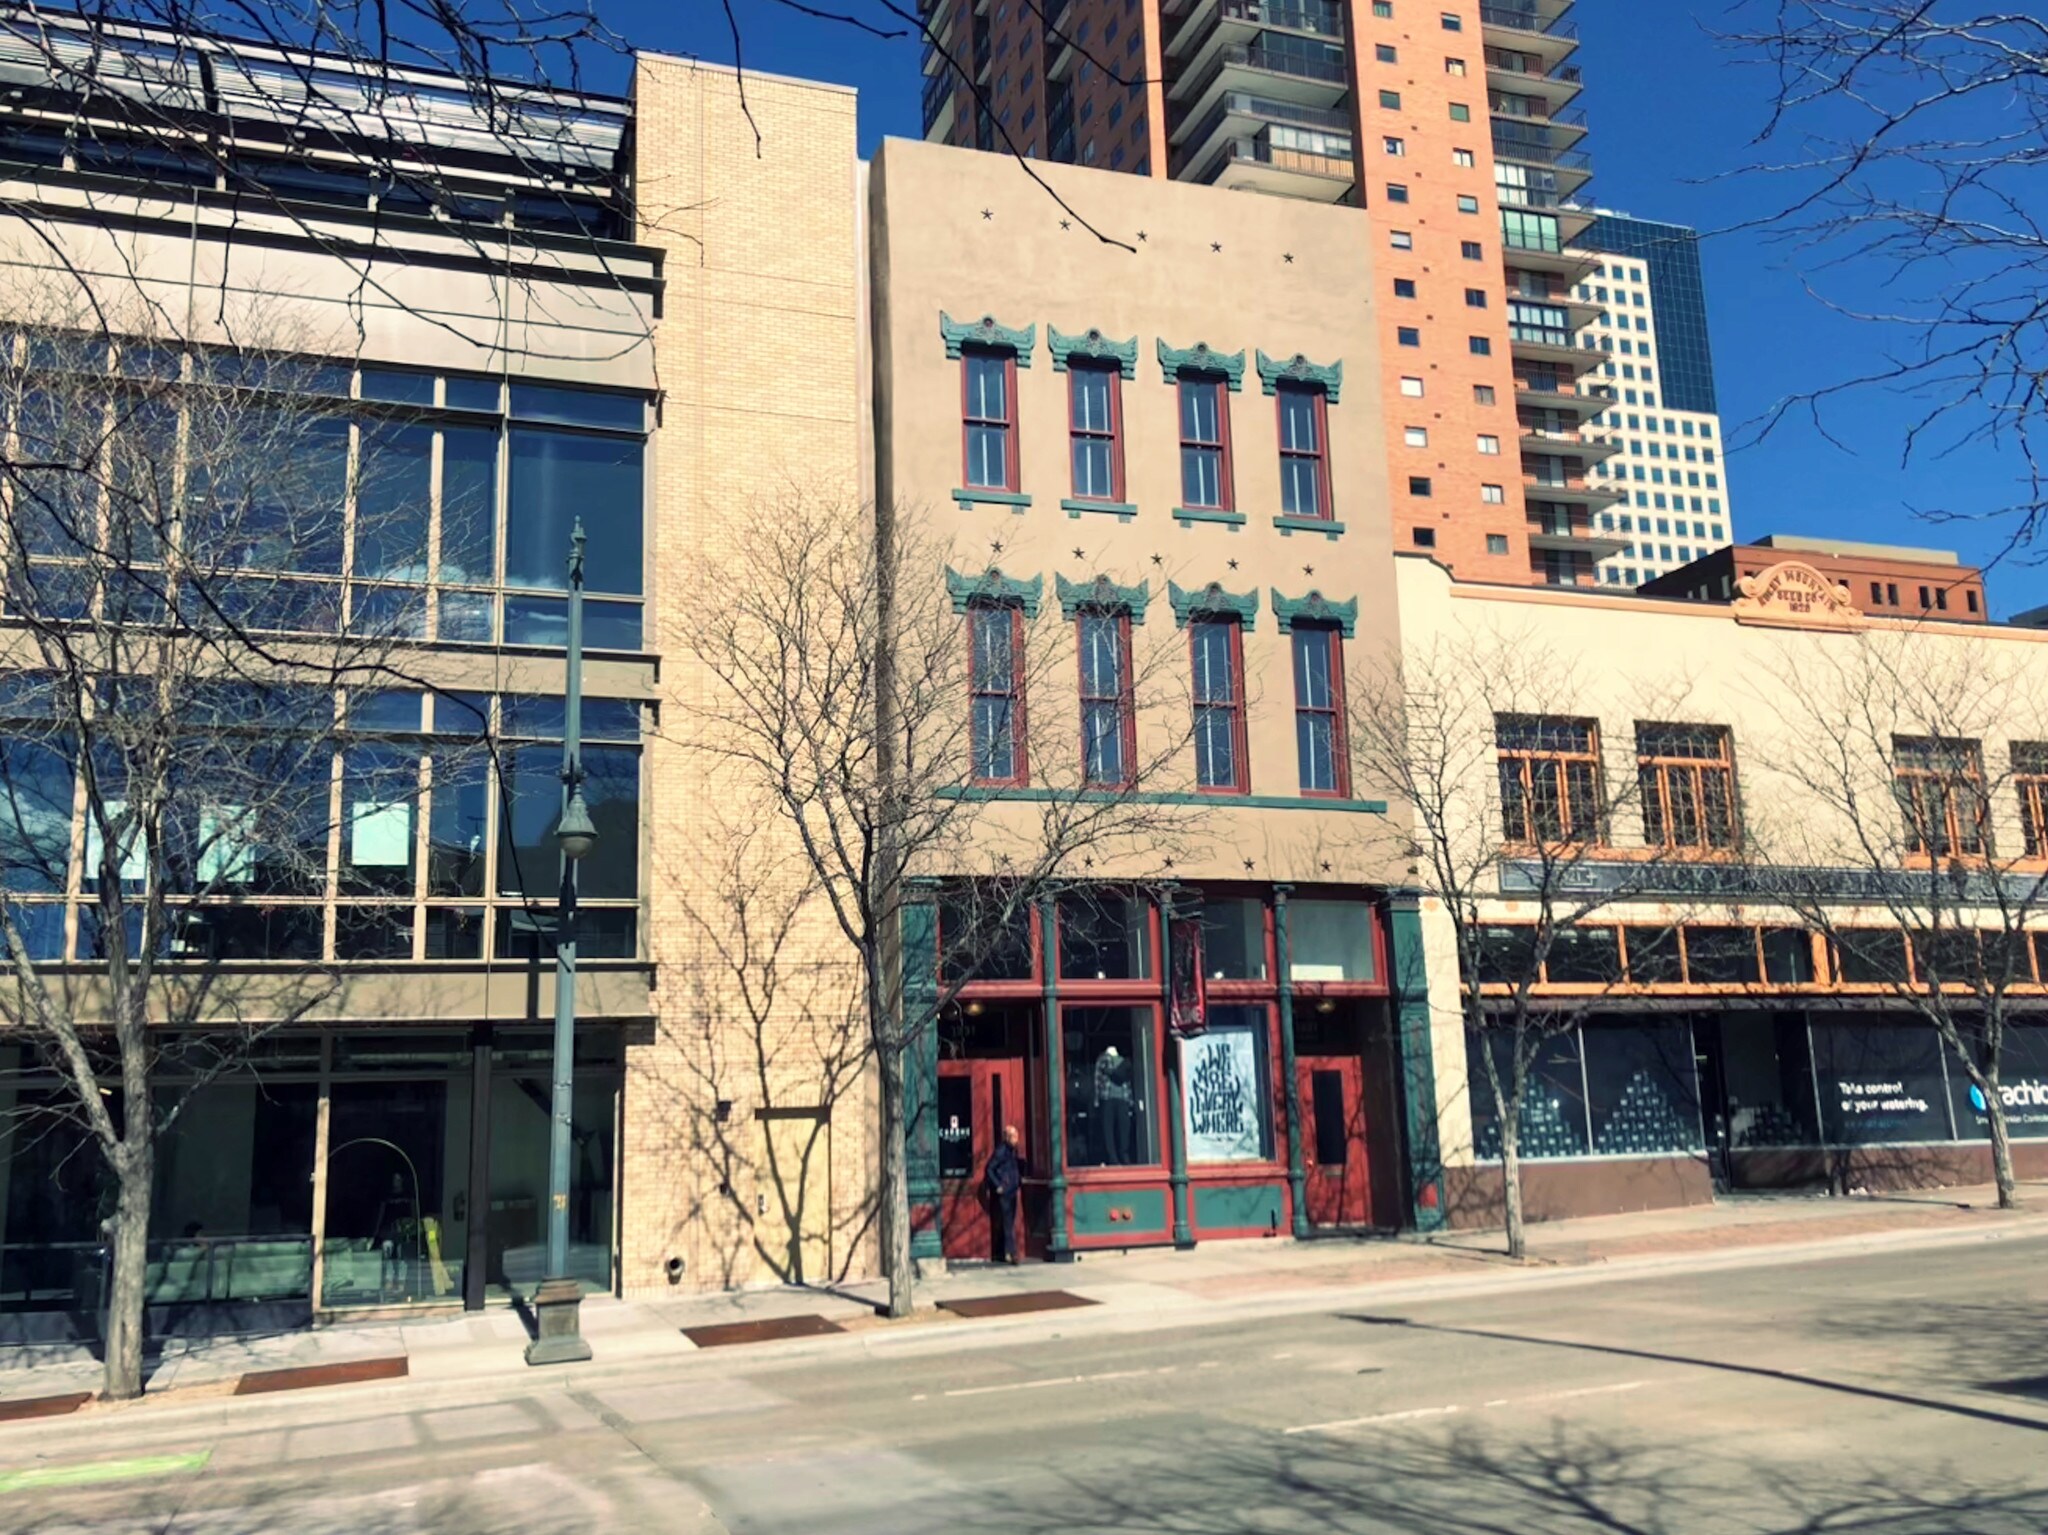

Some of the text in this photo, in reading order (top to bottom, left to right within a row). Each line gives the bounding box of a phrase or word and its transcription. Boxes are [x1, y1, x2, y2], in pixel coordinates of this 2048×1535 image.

[1207, 1043, 1231, 1075] WE
[1195, 1058, 1232, 1096] ARE
[1865, 1081, 1904, 1094] control
[1854, 1099, 1879, 1113] your
